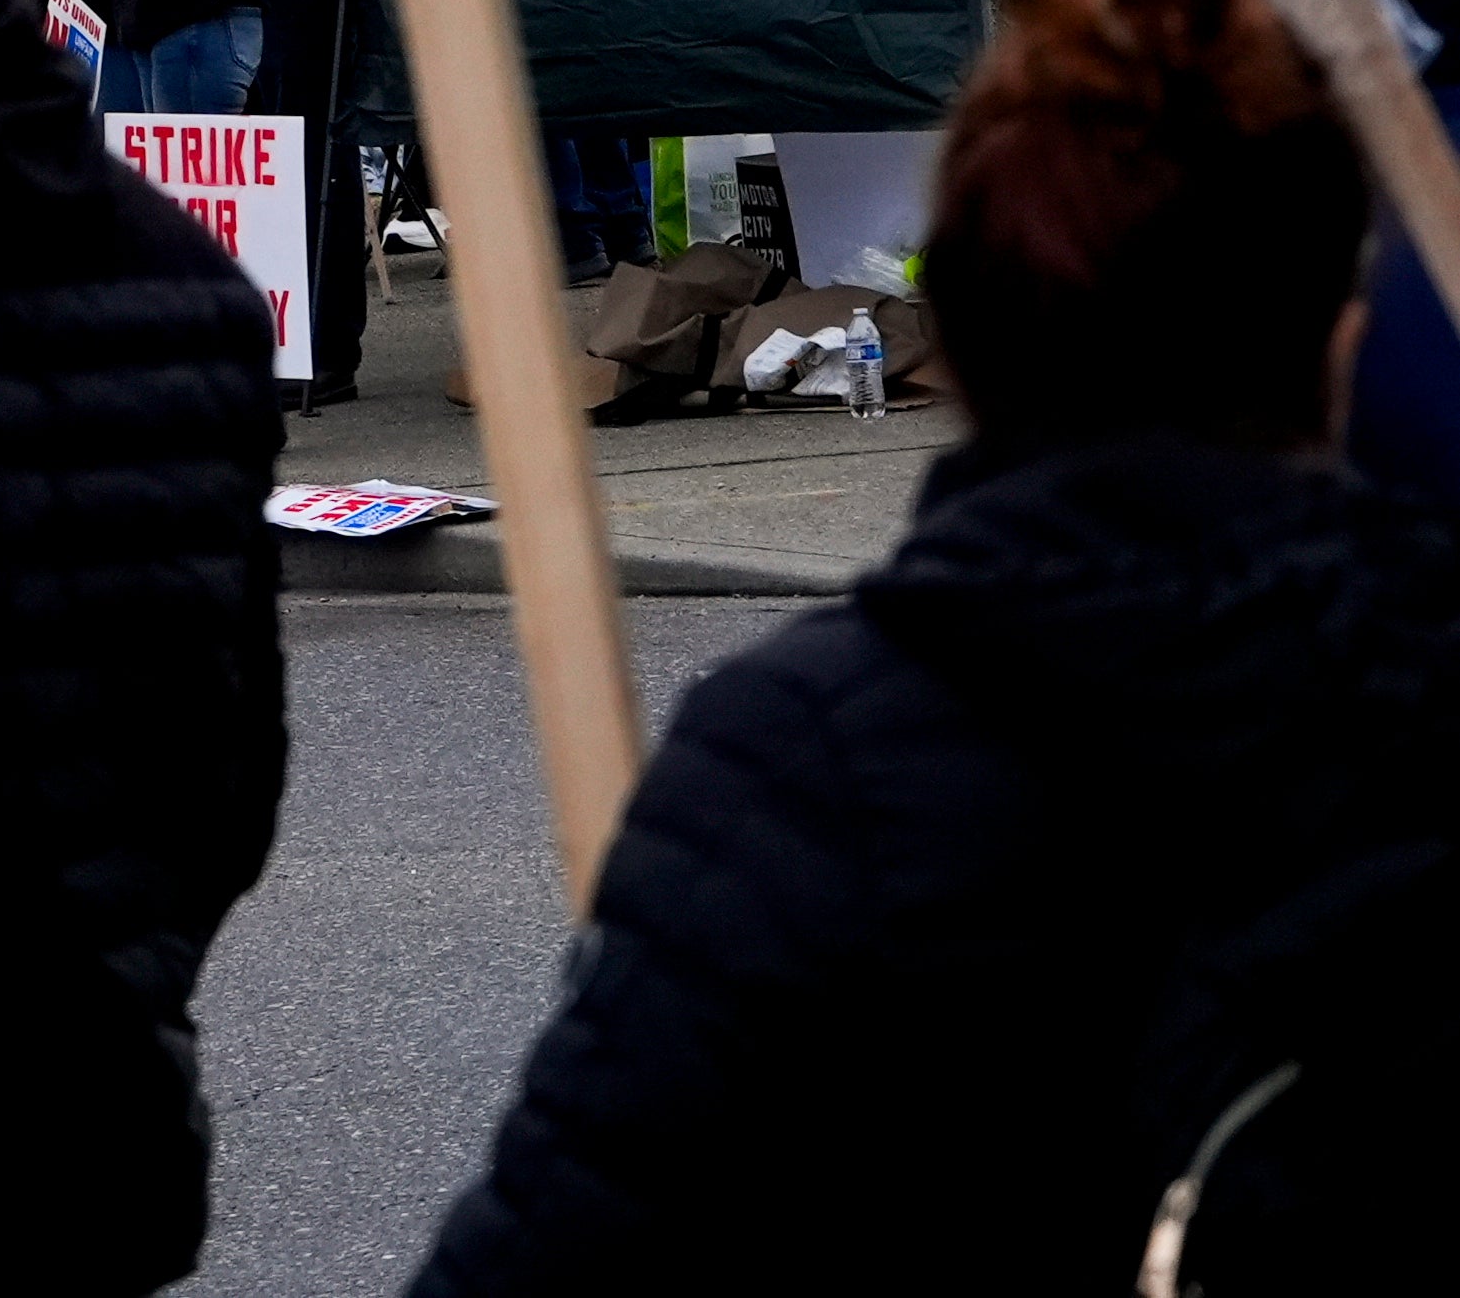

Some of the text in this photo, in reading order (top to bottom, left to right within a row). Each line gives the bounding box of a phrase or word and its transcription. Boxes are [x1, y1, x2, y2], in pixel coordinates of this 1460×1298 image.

[71, 4, 102, 43] UNION
[125, 125, 276, 186] STRIKE
[740, 184, 779, 208] MOTOR
[743, 216, 772, 238] CITY
